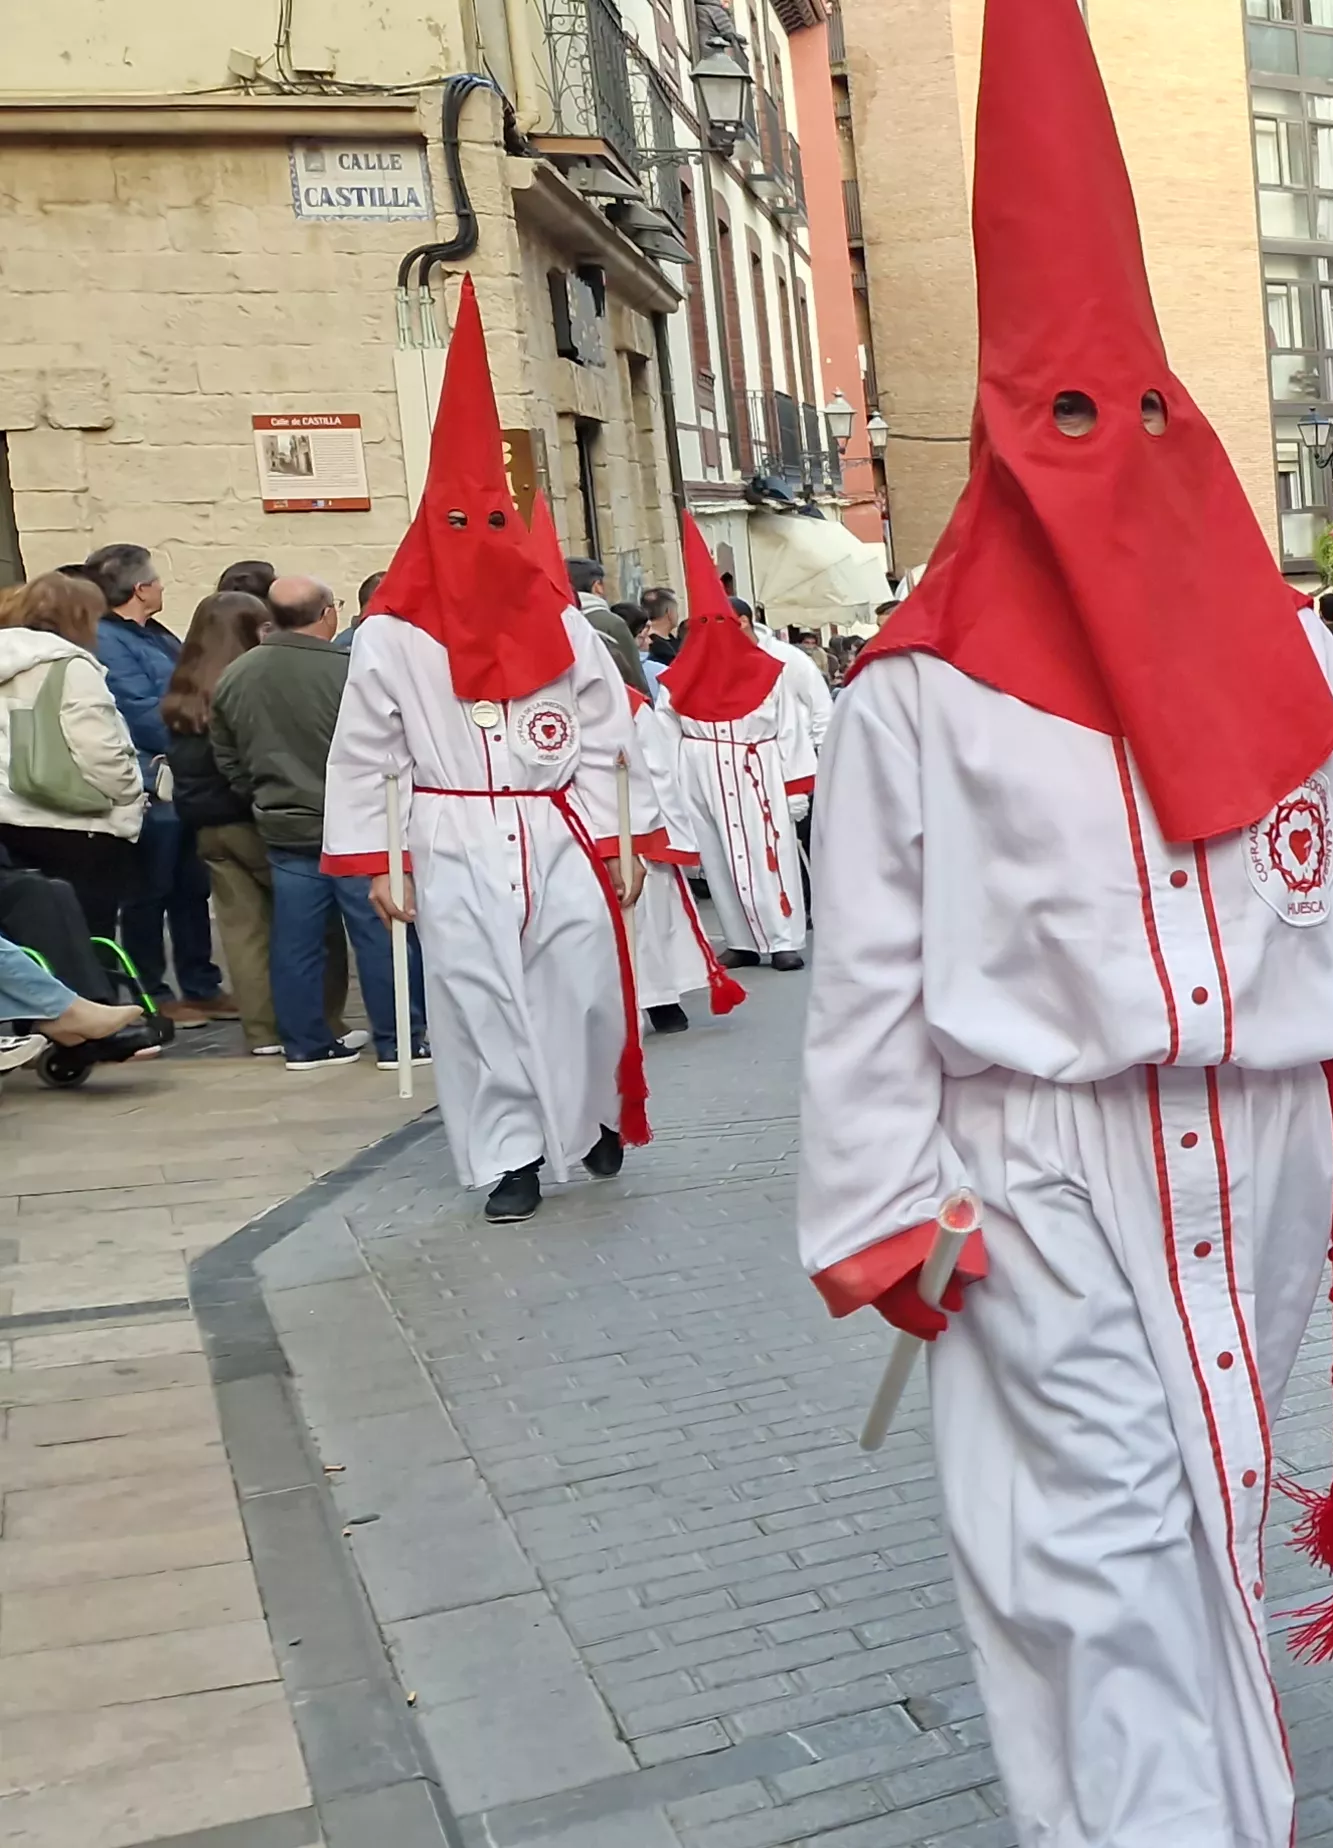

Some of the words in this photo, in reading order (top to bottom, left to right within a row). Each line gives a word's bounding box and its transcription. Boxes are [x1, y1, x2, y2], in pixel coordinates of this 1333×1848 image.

[338, 153, 402, 170] CALLE
[304, 187, 422, 208] CASTILLA
[270, 417, 289, 426] Calle
[291, 417, 301, 426] de
[302, 416, 342, 426] CASTILLA
[1249, 820, 1268, 882] COFRAD
[1287, 900, 1325, 915] HUESCA
